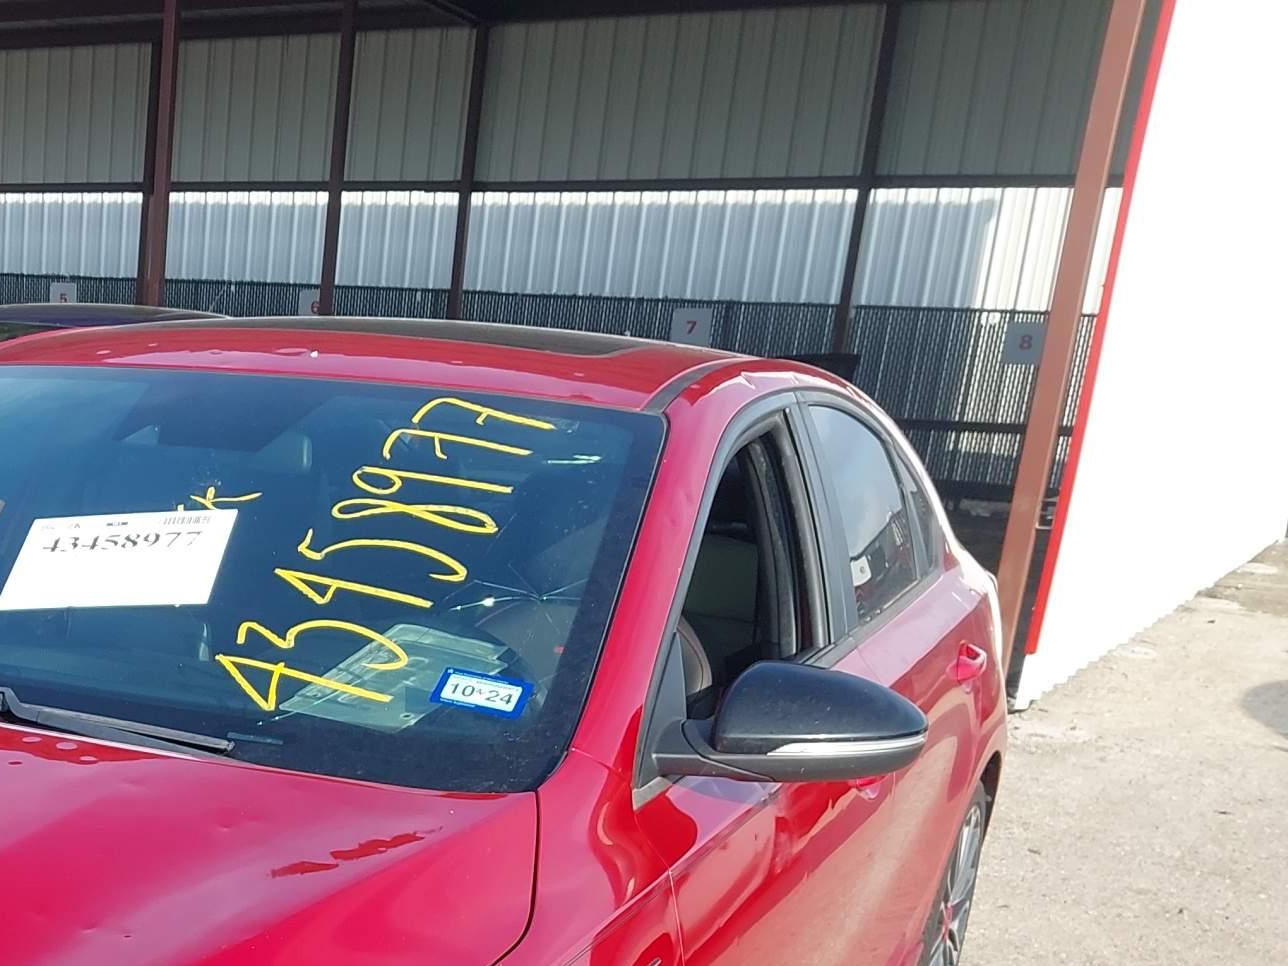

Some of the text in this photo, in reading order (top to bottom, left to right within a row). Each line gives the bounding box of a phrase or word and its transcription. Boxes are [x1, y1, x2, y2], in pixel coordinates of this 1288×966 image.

[686, 320, 697, 334] 7
[1019, 334, 1033, 350] 8
[42, 530, 205, 553] 43458977
